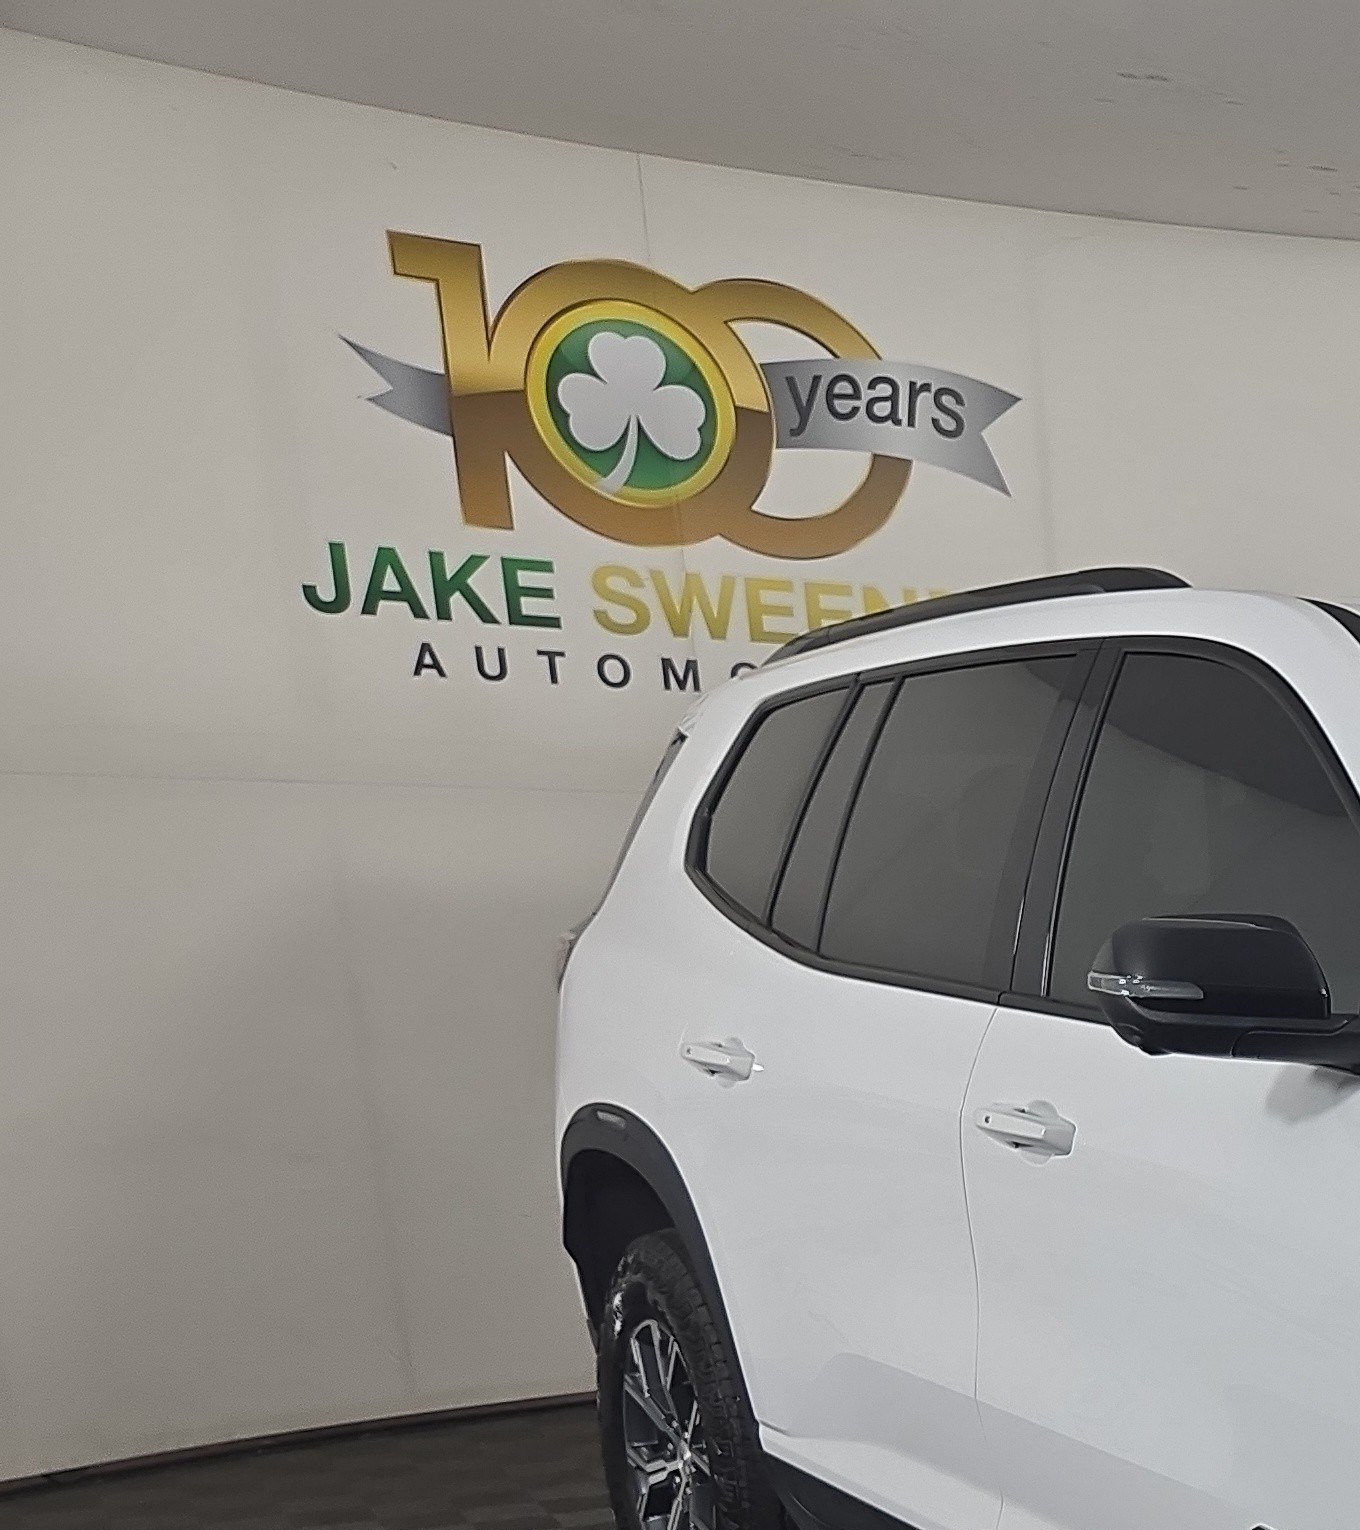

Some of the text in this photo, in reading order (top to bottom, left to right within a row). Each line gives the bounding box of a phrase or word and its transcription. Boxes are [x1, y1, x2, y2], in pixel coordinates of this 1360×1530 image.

[387, 229, 967, 560] 100 years
[302, 541, 956, 644] JAKE SWEE
[412, 641, 760, 693] AUTOM
